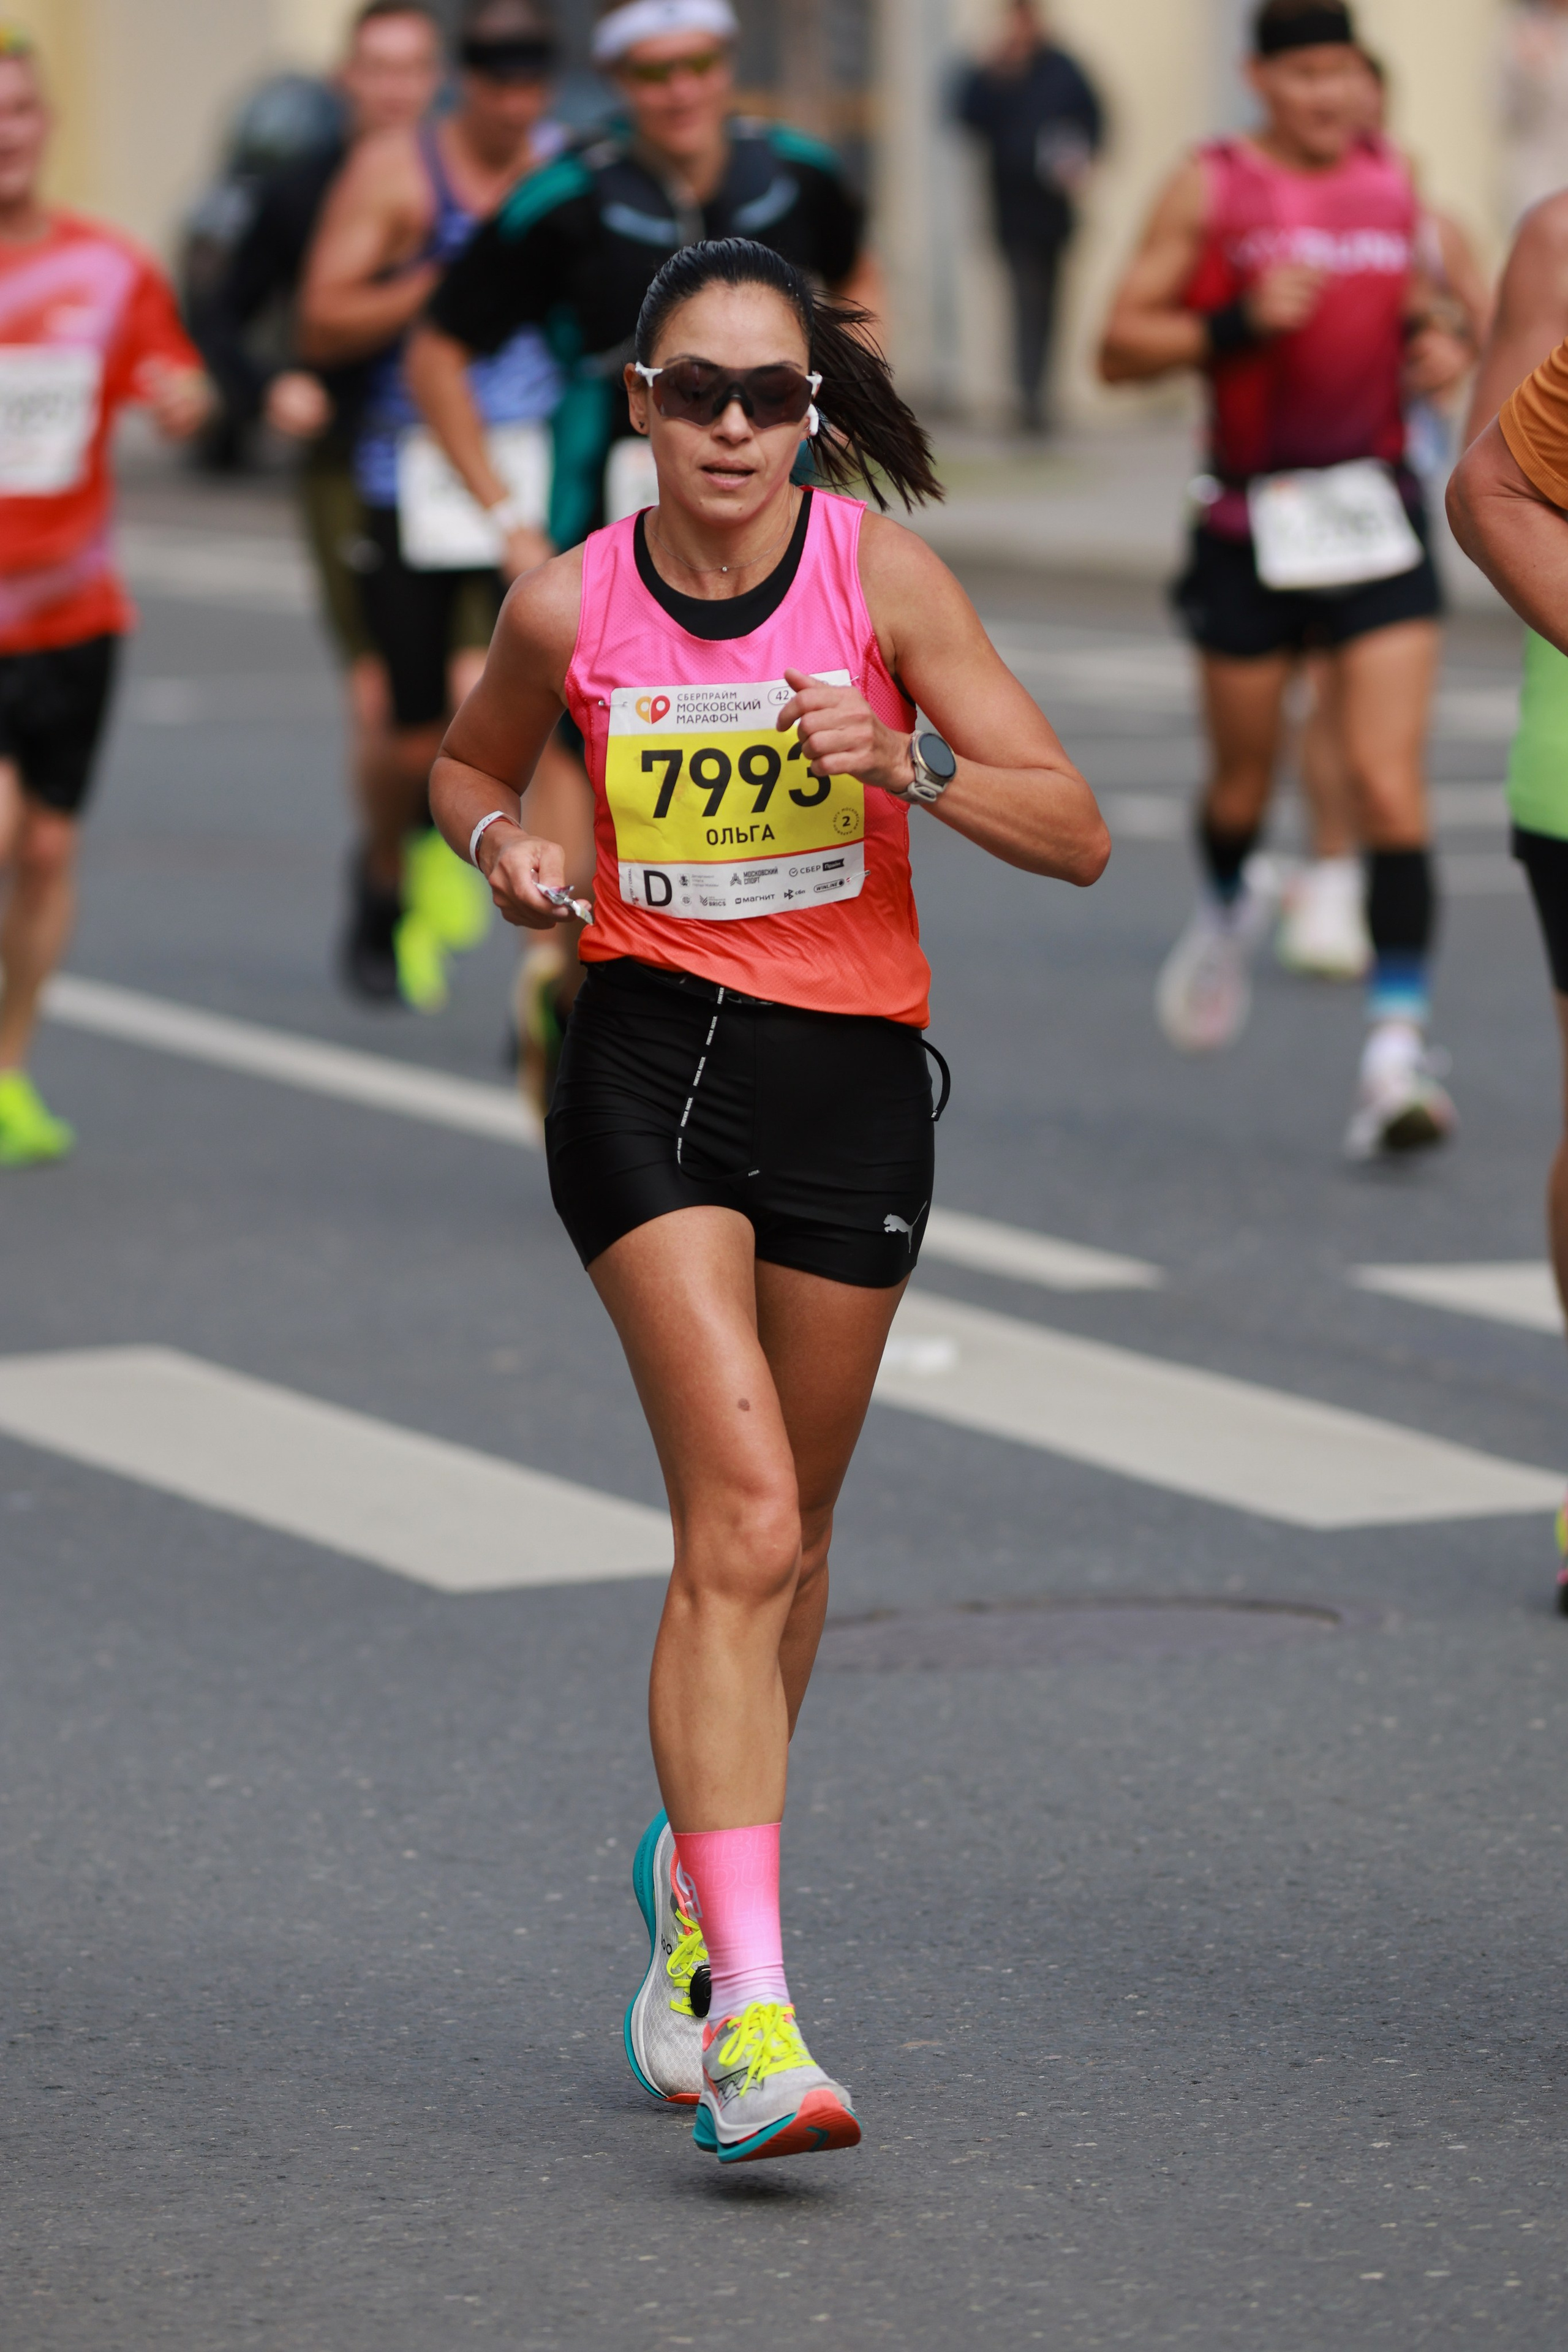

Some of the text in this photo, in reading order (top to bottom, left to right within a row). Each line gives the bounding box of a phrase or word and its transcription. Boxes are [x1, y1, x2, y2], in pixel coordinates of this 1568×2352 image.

[677, 691, 737, 701] СБЕРПРАЙМ
[676, 698, 761, 712] МОСКОВСКИЙ
[676, 713, 739, 725] МАРАФОН
[641, 741, 831, 818] 7993
[842, 815, 851, 827] 2
[706, 824, 775, 845] ОЛЬГА
[743, 867, 778, 878] МОСКОВСКИЙ
[800, 865, 821, 874] СБЕР
[744, 876, 760, 885] СПОРТ
[816, 882, 839, 891] WINLINE
[643, 870, 673, 907] D
